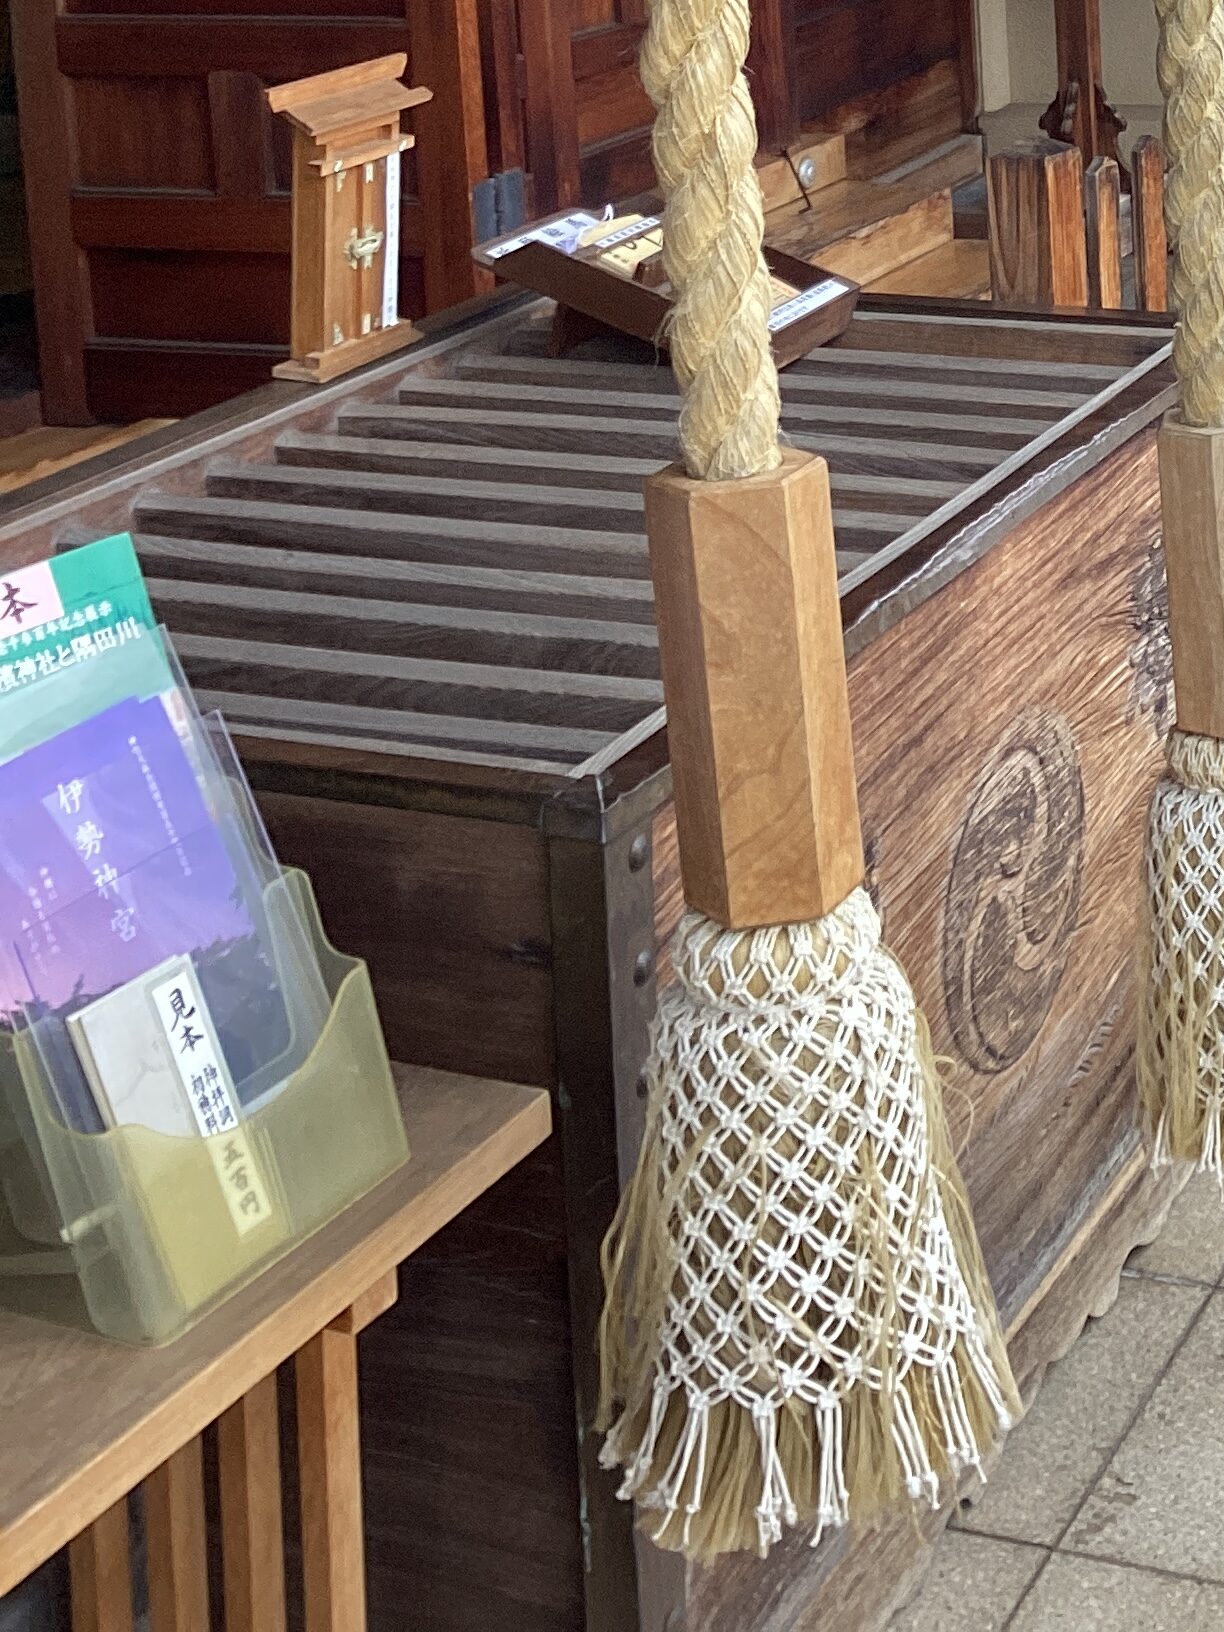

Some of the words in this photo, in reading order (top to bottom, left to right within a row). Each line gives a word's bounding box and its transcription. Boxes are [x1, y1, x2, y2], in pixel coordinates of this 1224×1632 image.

[57, 779, 137, 942] 伊勢神宮
[169, 988, 204, 1055] 見本
